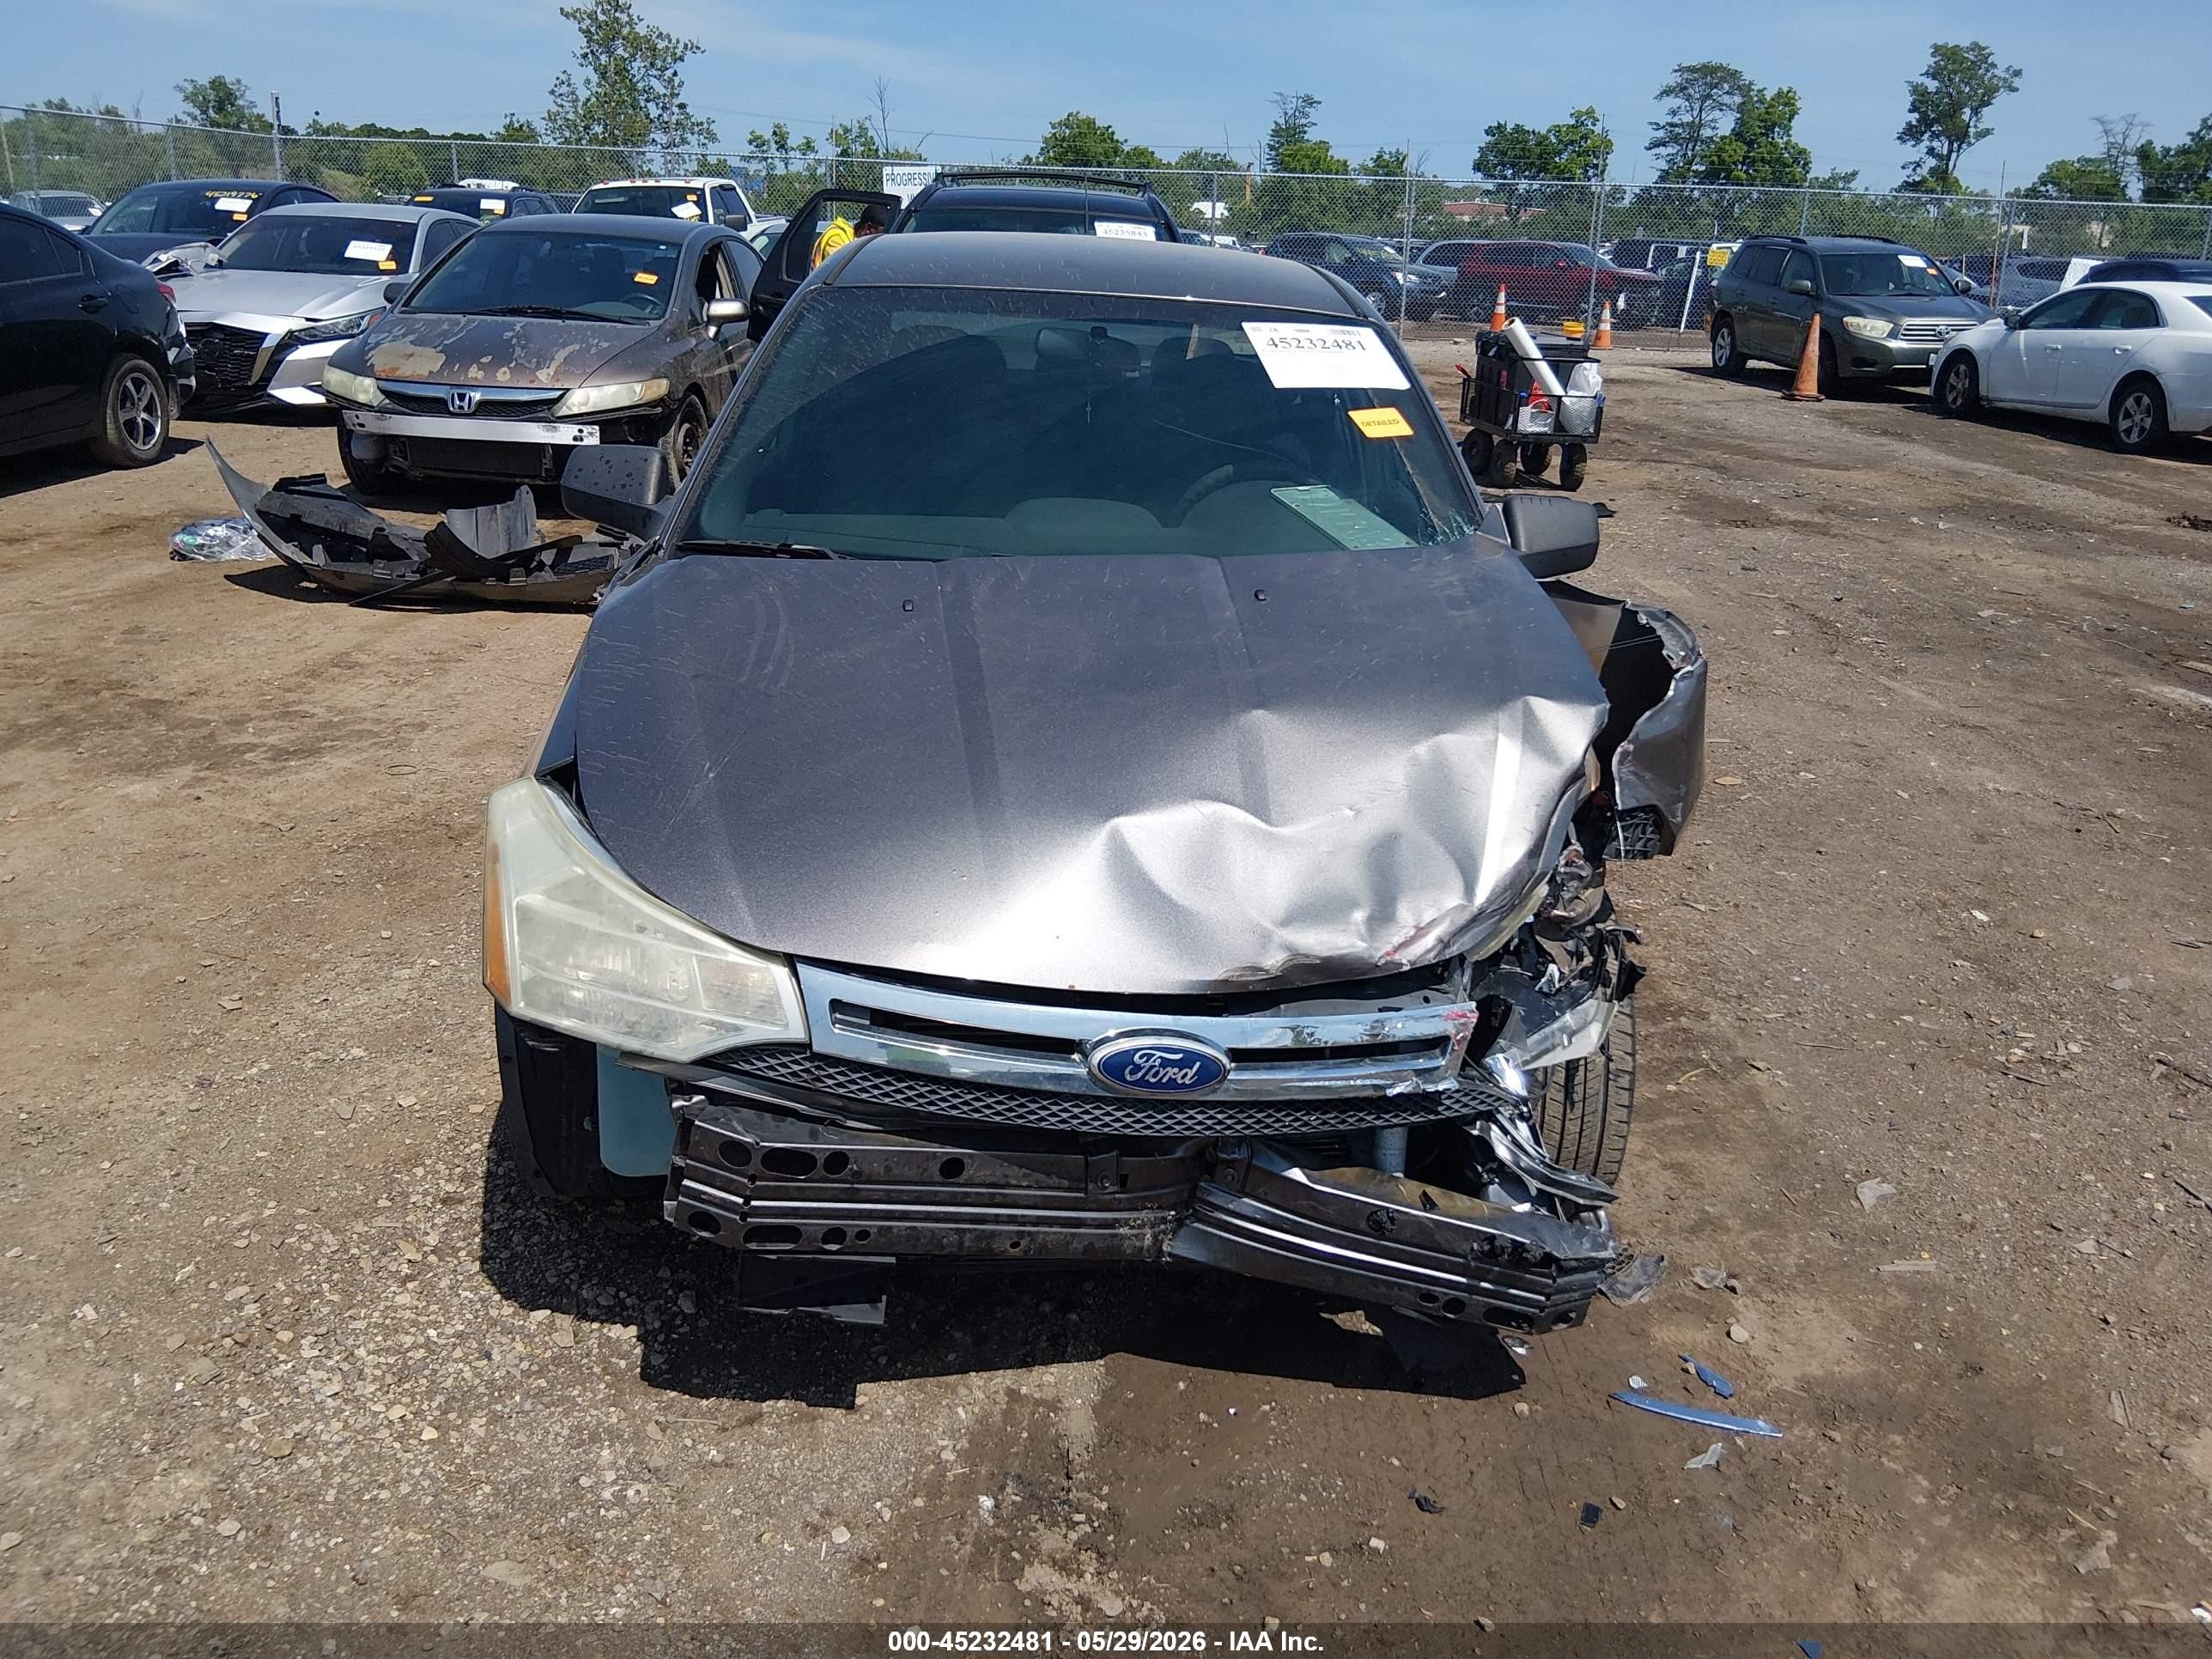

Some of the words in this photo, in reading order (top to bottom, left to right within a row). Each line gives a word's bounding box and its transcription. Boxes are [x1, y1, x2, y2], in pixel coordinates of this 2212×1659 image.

[885, 173, 935, 187] PROGRESSIV
[1266, 337, 1367, 351] 45232481
[1123, 1049, 1202, 1085] Ford
